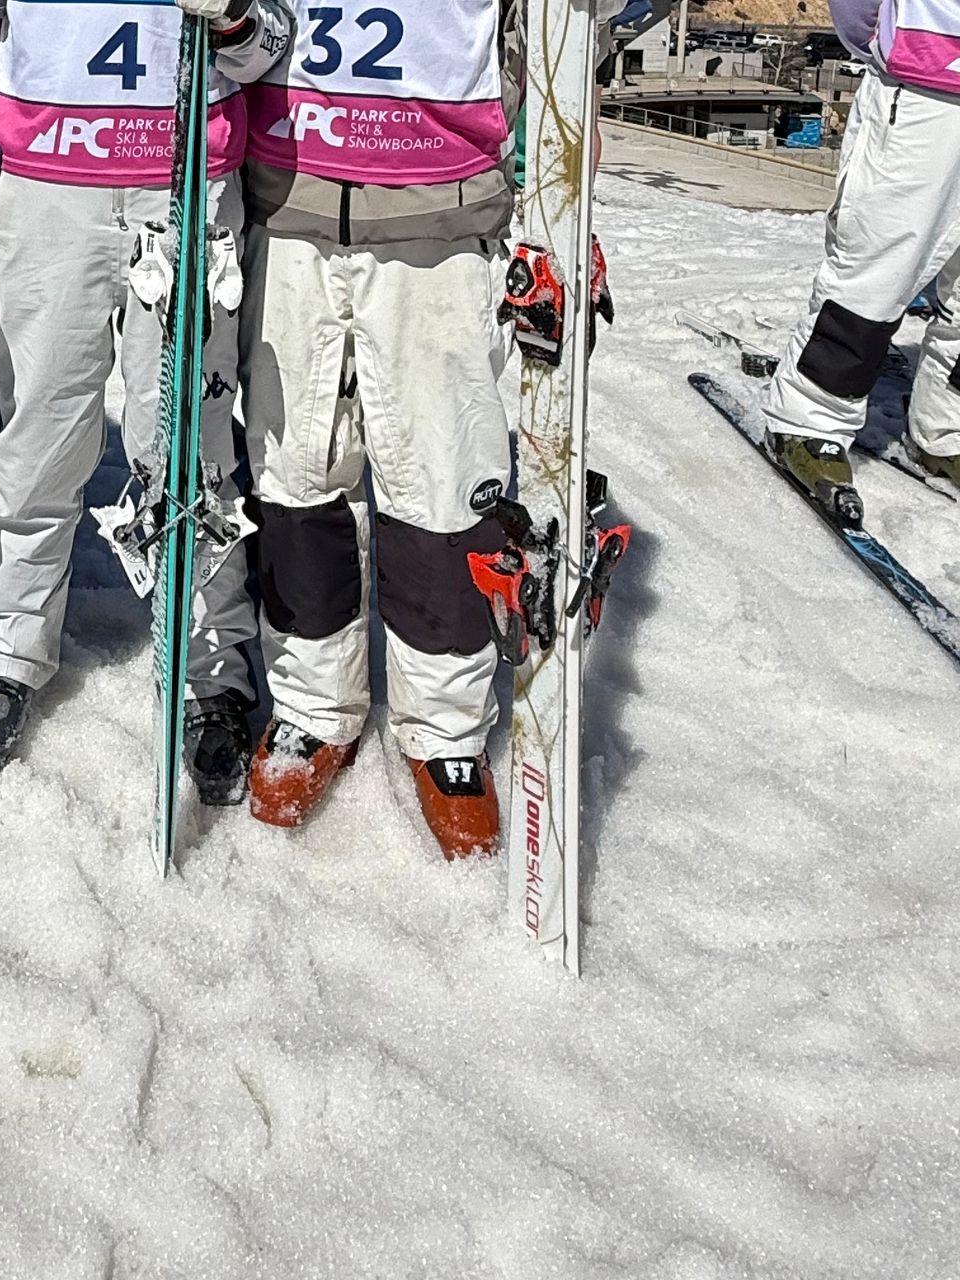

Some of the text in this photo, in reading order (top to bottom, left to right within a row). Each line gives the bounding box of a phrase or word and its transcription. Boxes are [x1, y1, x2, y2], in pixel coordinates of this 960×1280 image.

[300, 6, 405, 81] 32
[86, 21, 147, 91] 4
[351, 109, 390, 123] PARK
[391, 110, 422, 124] CITY
[350, 122, 383, 136] SKI &
[58, 117, 114, 158] PC
[118, 118, 154, 131] PARK
[115, 131, 149, 144] SKI &
[347, 136, 444, 151] SNOWBOARD
